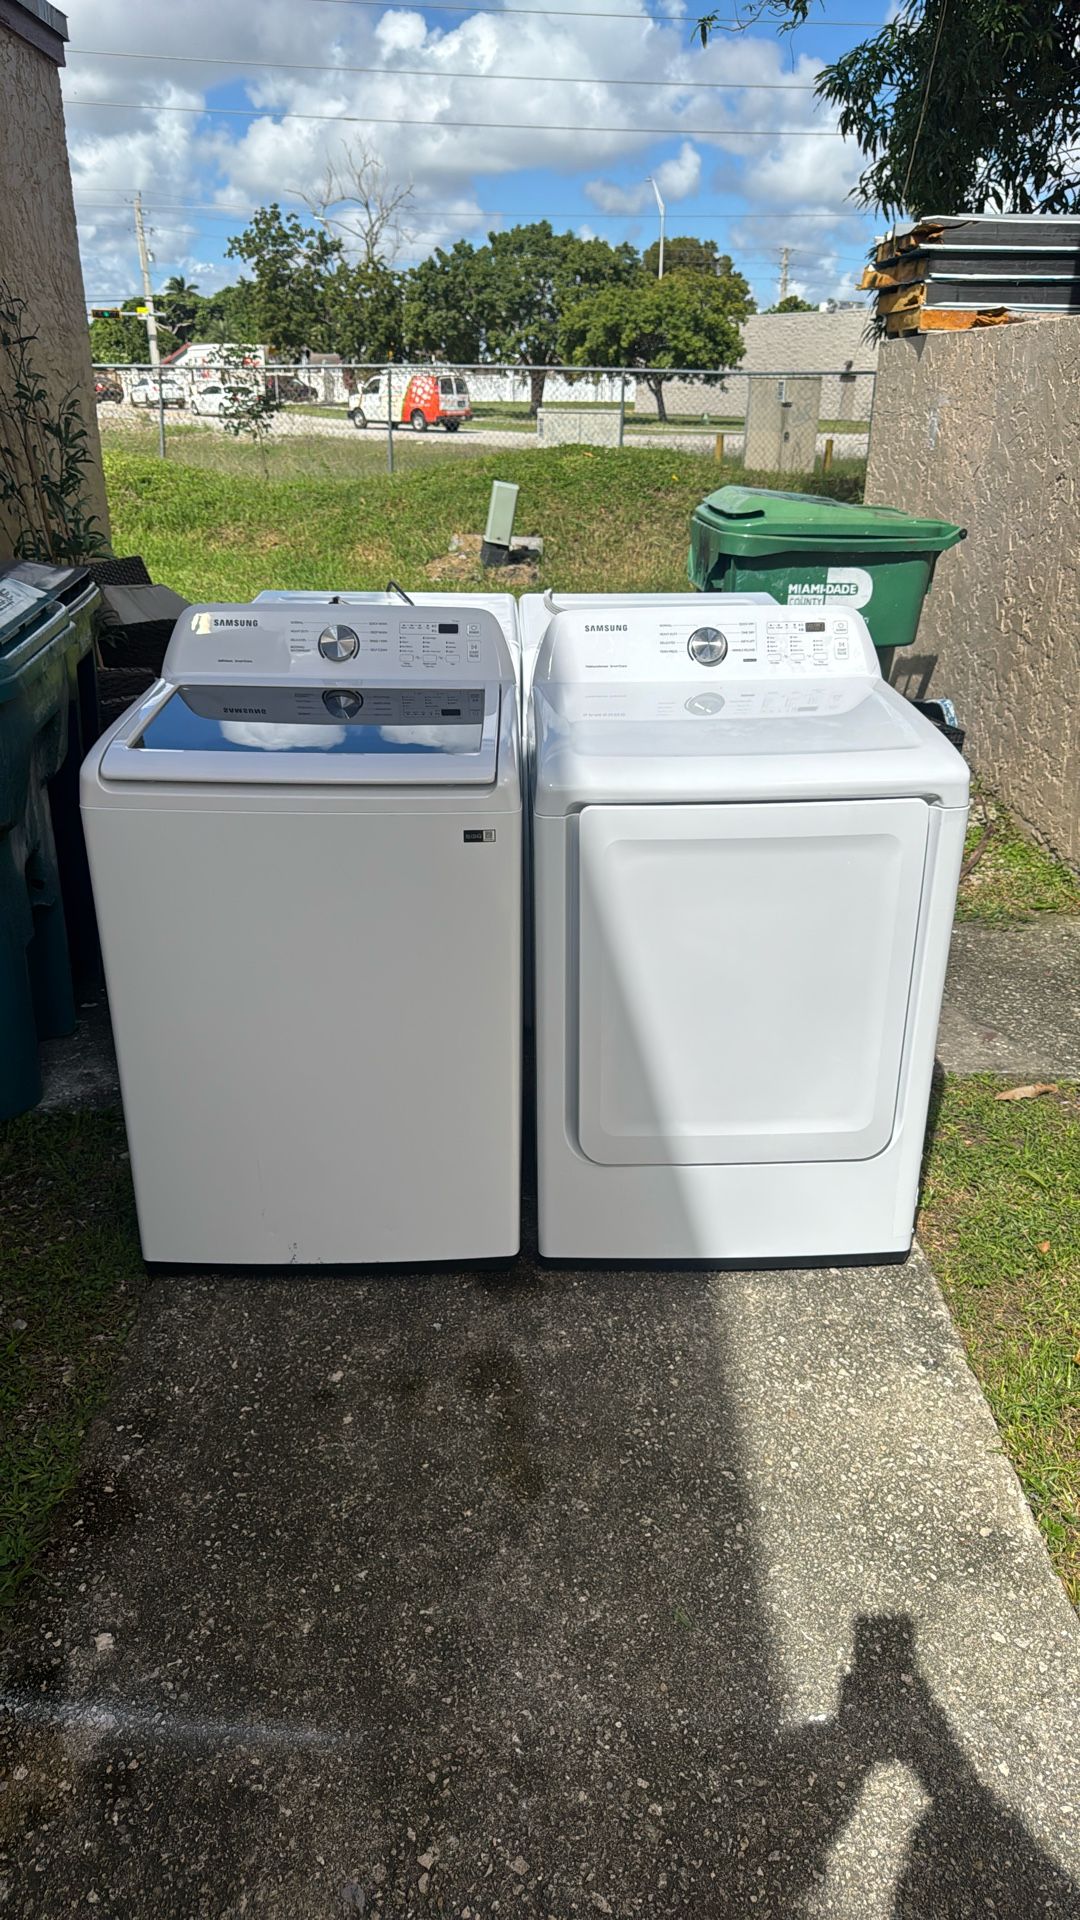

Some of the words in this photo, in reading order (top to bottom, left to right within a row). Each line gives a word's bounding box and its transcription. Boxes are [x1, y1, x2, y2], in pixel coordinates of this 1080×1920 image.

[788, 584, 857, 594] MIAMI-DADE
[213, 619, 258, 627] SAMSUNG
[584, 624, 628, 632] SAMSUNG
